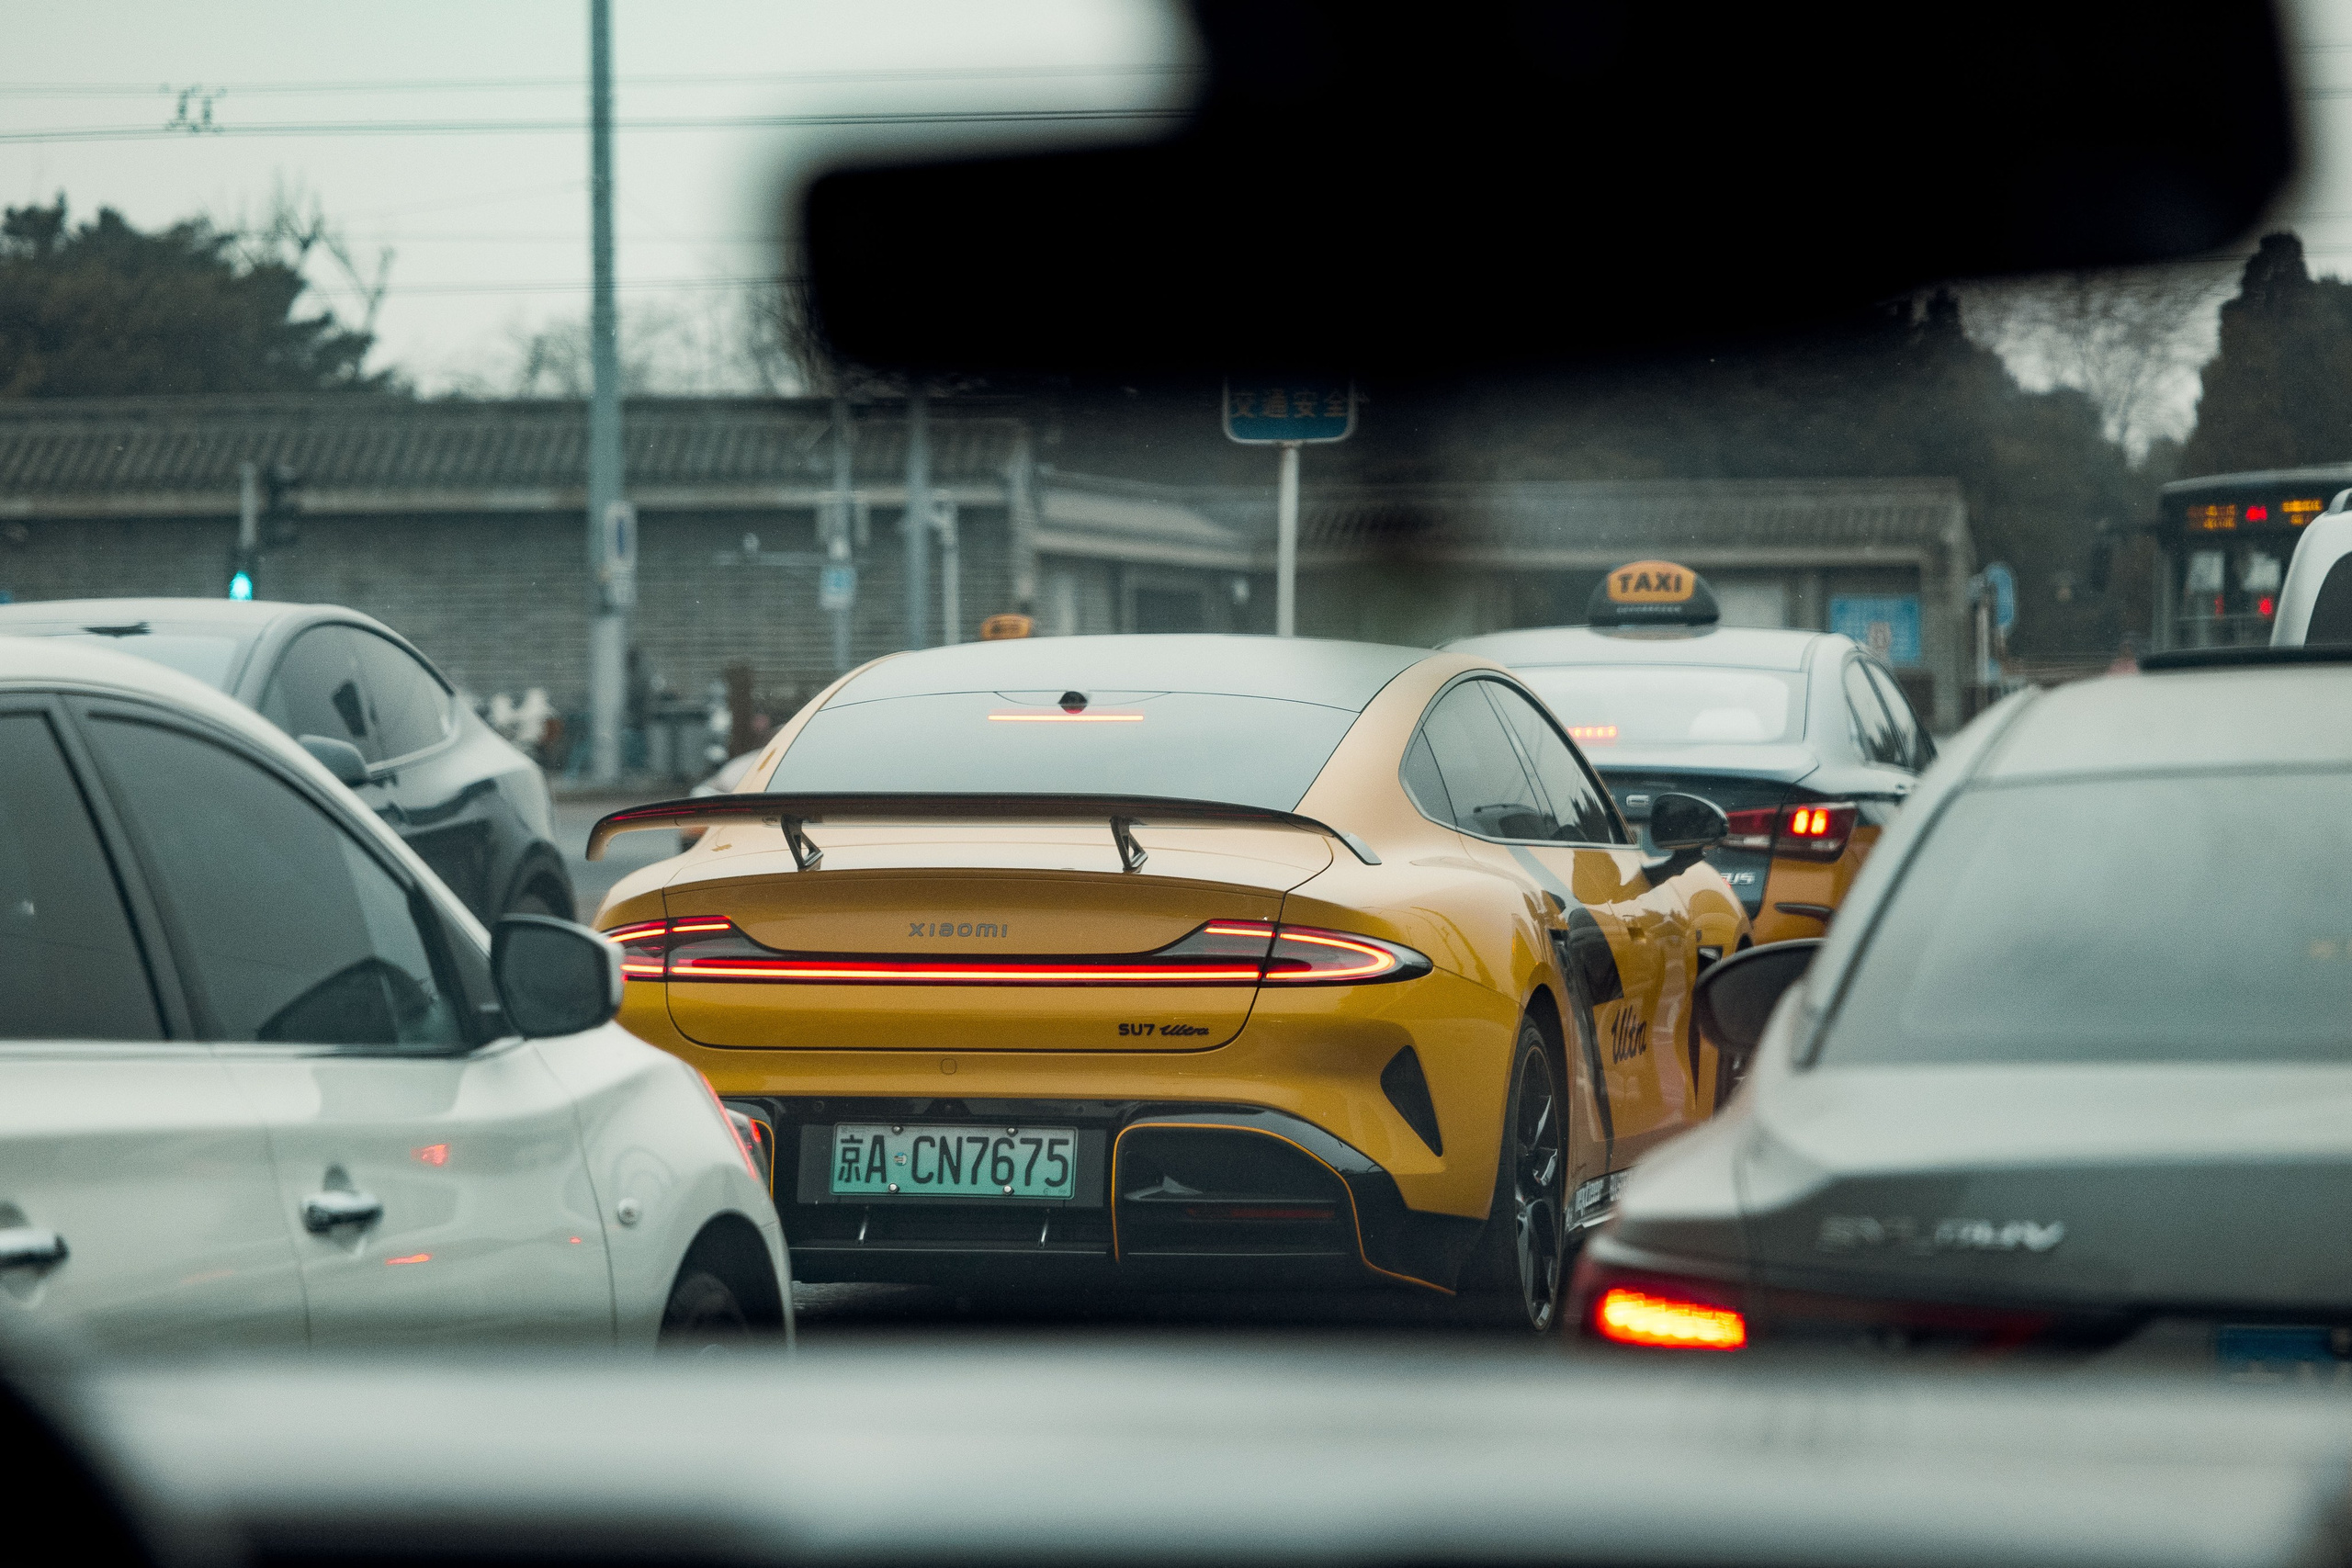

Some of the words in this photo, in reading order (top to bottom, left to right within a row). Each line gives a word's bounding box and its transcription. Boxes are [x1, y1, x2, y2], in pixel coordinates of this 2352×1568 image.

[1231, 388, 1347, 418] 交通安全
[1618, 571, 1682, 593] TAXI
[1118, 1023, 1155, 1036] SU7
[1159, 1024, 1209, 1036] Ultra
[1611, 1005, 1646, 1065] Ultra
